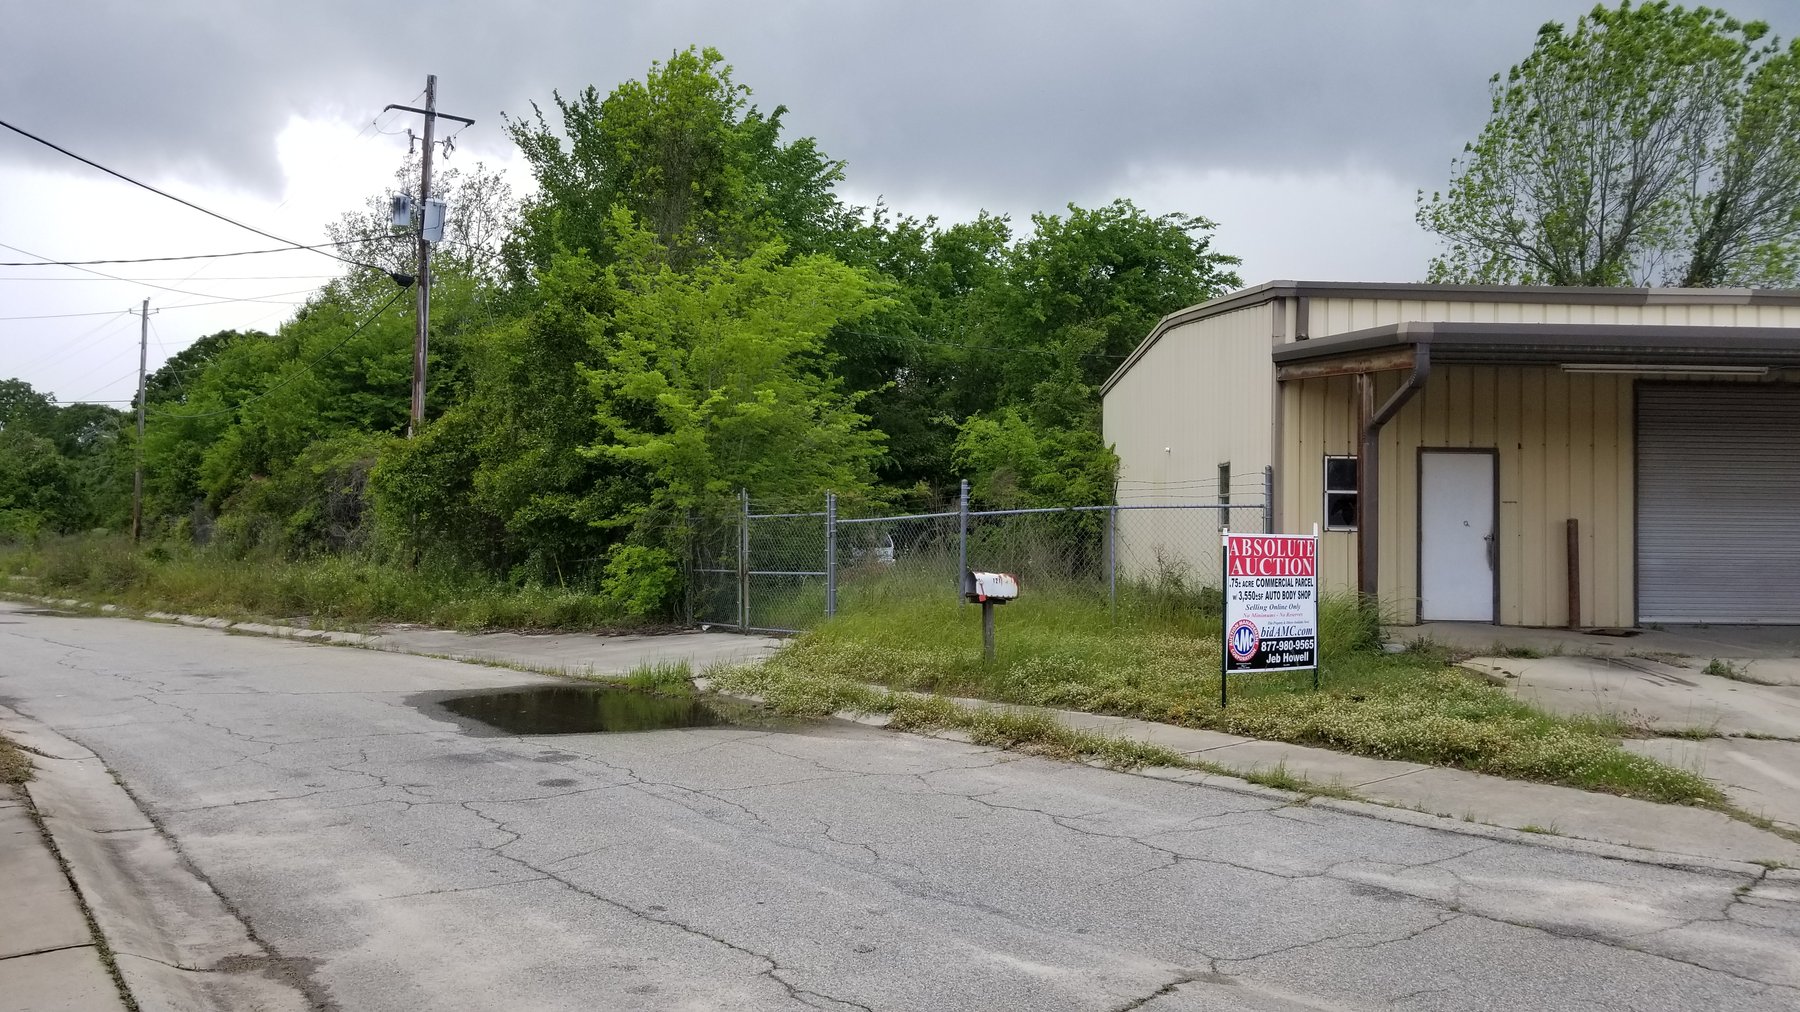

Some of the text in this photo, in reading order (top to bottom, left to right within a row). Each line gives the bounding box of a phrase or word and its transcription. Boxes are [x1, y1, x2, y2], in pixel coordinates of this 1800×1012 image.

[1229, 538, 1314, 557] ABSOLUTE
[1231, 557, 1313, 576] AUCTION
[1242, 580, 1255, 588] ACRE
[1255, 578, 1294, 588] COMMERCIAL
[1294, 577, 1314, 587] PARCEL
[1264, 590, 1281, 600] AUTO
[1281, 590, 1297, 600] BODY
[1297, 590, 1311, 600] SHOP
[1245, 602, 1301, 612] Selling Online Only
[1260, 625, 1313, 638] bidAMC.com
[1234, 628, 1254, 653] AMC
[1260, 639, 1314, 652] 877-980-9565
[1266, 651, 1309, 664] Jeb Howell
